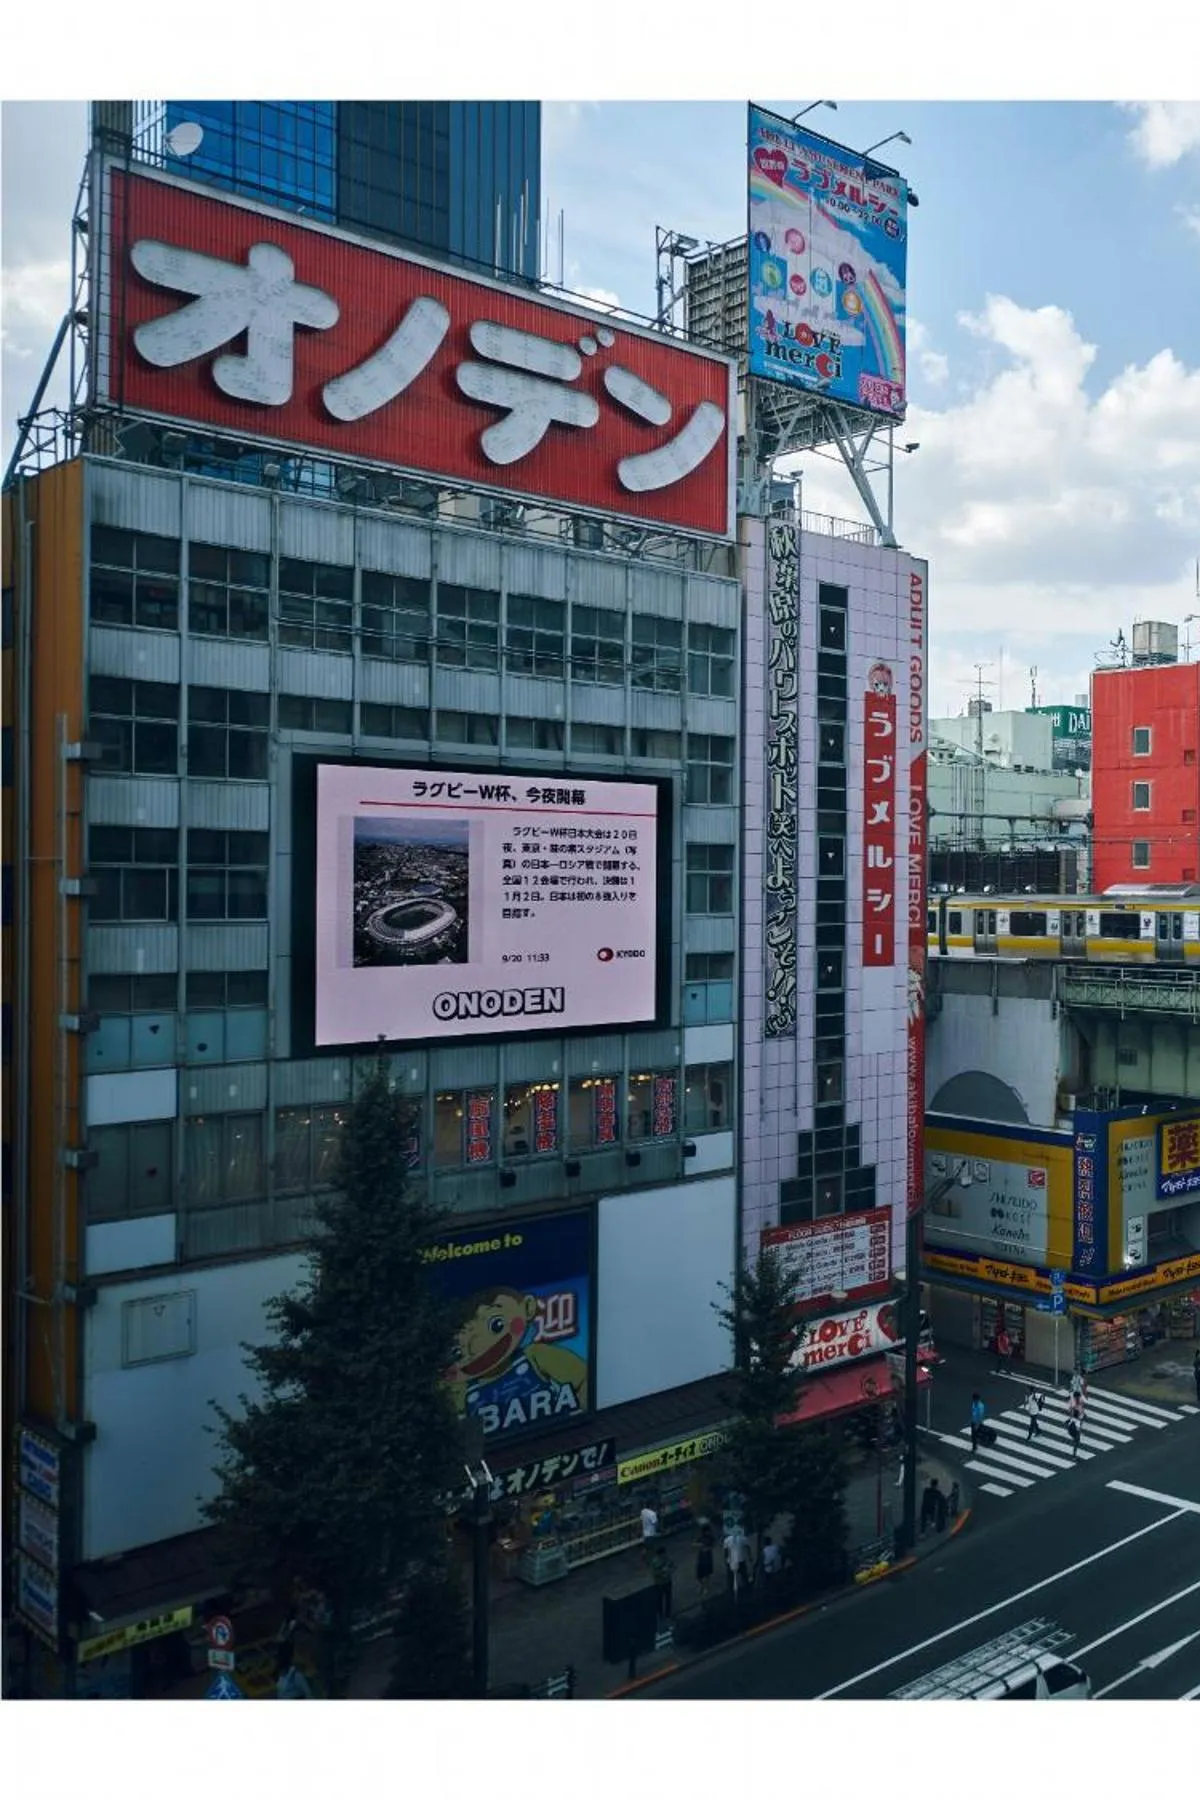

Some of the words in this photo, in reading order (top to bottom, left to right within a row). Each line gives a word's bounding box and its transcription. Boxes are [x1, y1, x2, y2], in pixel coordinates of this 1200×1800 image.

[791, 158, 898, 217] ラブメルシー
[784, 320, 842, 354] LOVE
[130, 240, 726, 494] オノデン
[766, 340, 842, 378] merci
[909, 571, 923, 649] ADULT
[909, 655, 923, 744] GOODS
[412, 781, 586, 807] ラグビーW杯、今夜開幕
[867, 711, 893, 954] ラブメルシー
[908, 785, 923, 846] LOVE
[908, 853, 923, 928] MERCI
[502, 954, 523, 963] 9/20
[527, 953, 550, 963] 11:33
[432, 987, 566, 1020] ONODEN
[1167, 1123, 1200, 1169] 薬
[421, 1238, 501, 1263] Welcome
[504, 1233, 524, 1249] to
[1053, 1295, 1063, 1309] P
[804, 1329, 873, 1366] merci
[807, 1316, 867, 1346] LOVE
